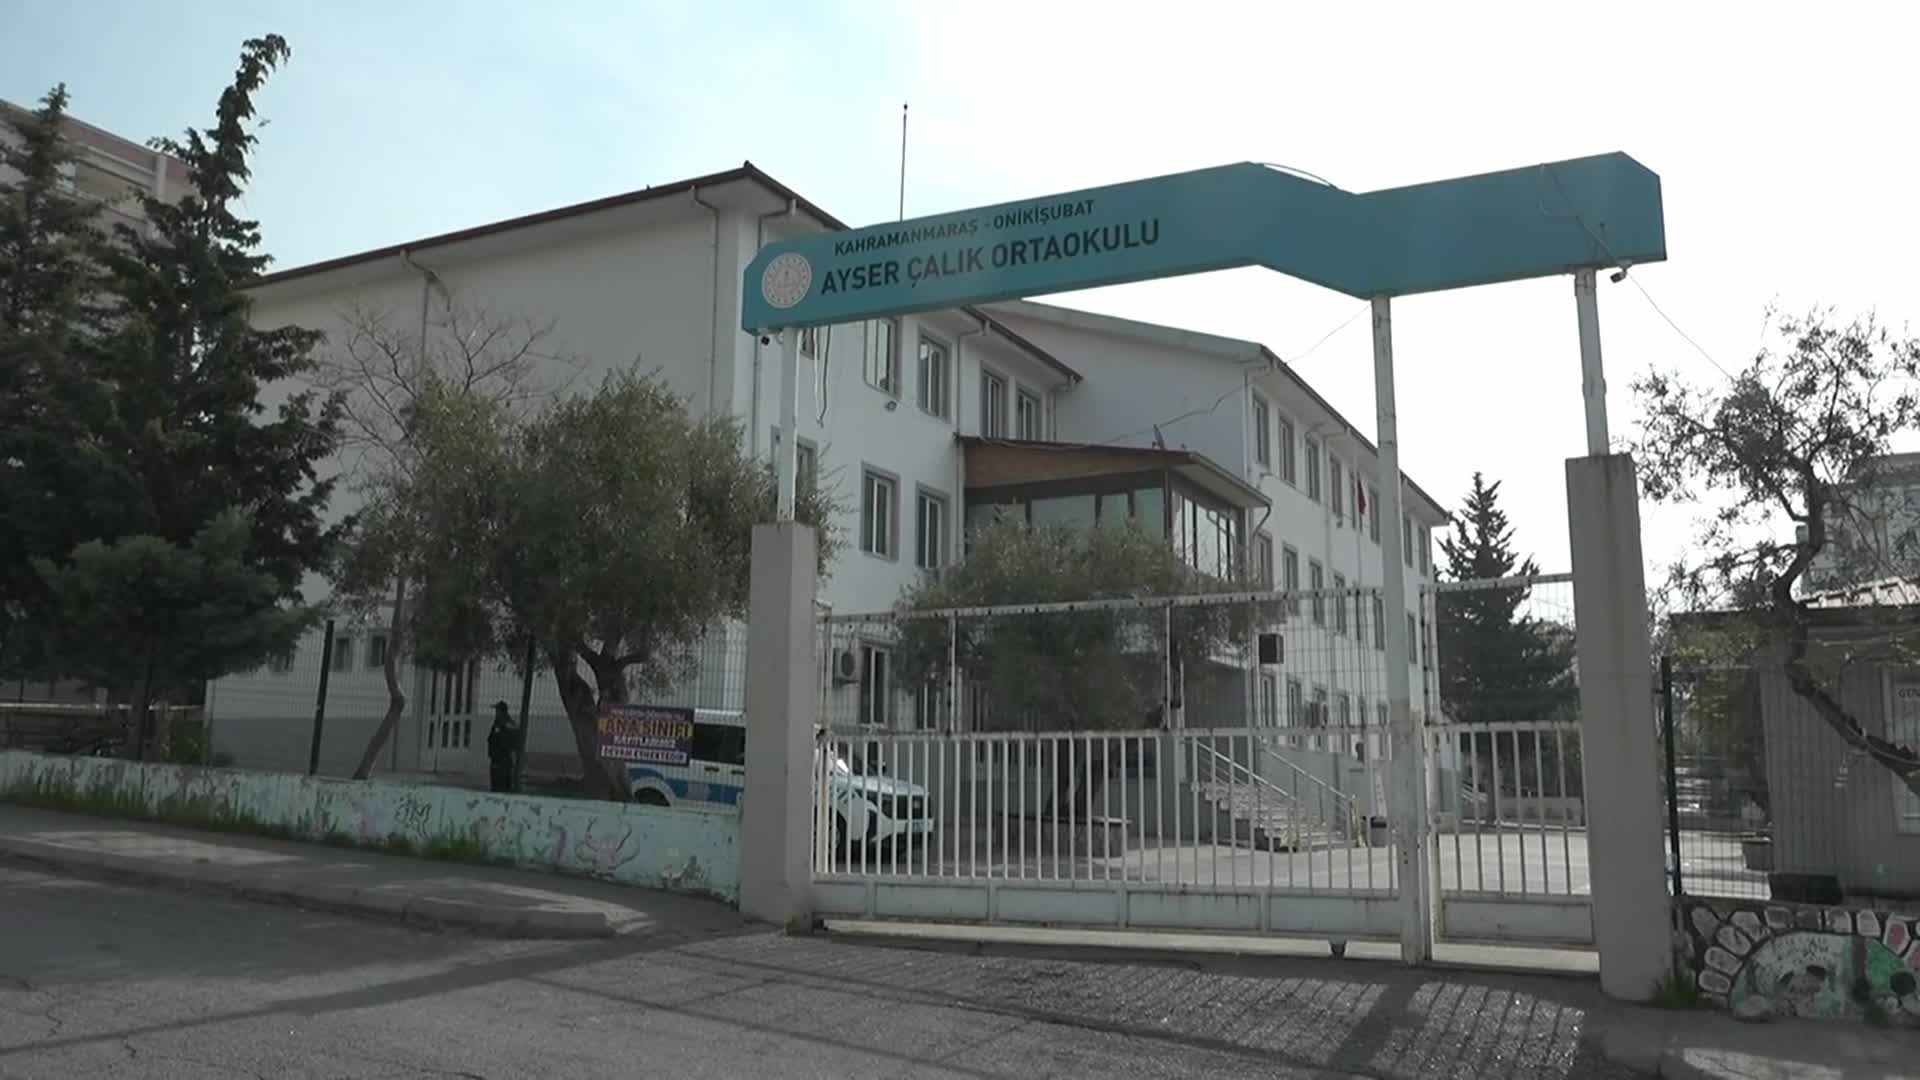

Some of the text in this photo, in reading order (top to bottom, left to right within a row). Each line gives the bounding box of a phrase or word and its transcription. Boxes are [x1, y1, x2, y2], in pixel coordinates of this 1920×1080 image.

[821, 260, 901, 296] AYSER
[906, 246, 985, 289] ÇALIK
[991, 217, 1160, 269] ORTAOKULU
[834, 219, 979, 257] KAHRAMANMARAŞ
[993, 199, 1095, 230] ONİKİŞUBAT
